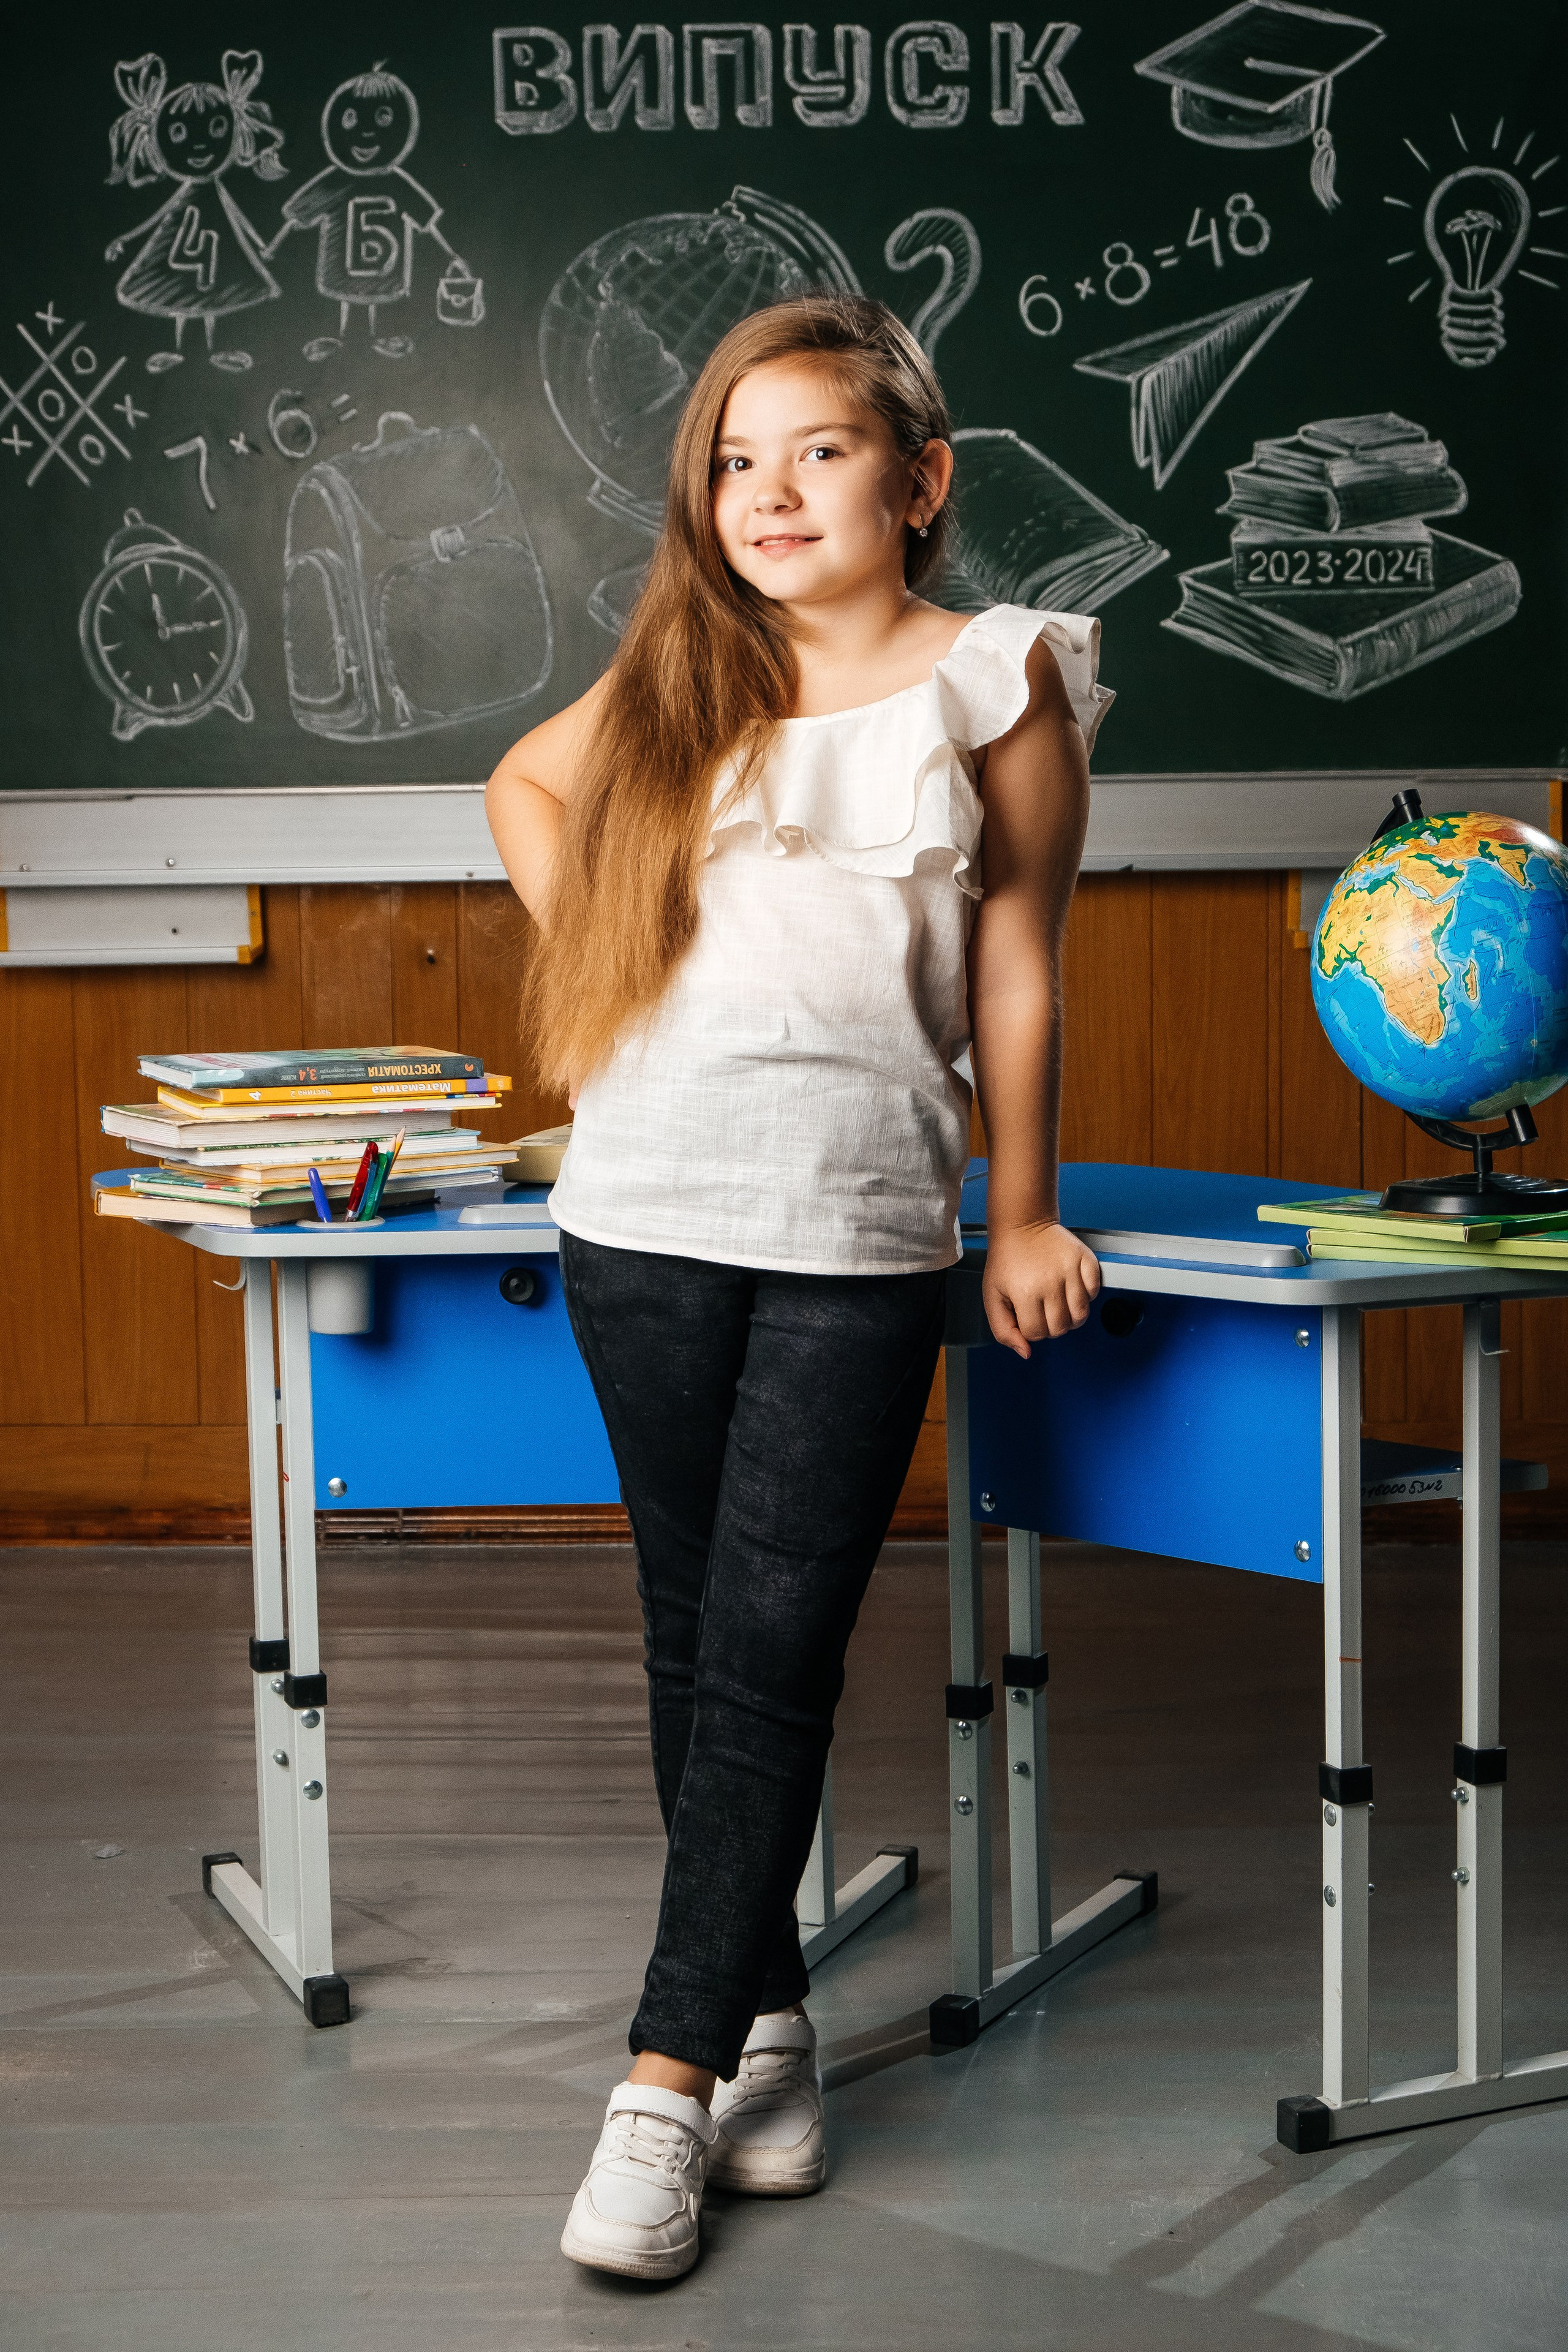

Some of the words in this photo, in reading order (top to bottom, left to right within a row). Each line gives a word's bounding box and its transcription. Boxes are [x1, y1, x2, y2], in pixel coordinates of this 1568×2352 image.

[492, 20, 1085, 135] ВИПУСК
[167, 205, 219, 292] 4
[298, 1066, 317, 1081] 3,4
[368, 1063, 442, 1077] ХРЕСТОМАТІЯ
[371, 1082, 451, 1094] Математика
[249, 1090, 262, 1101] 4
